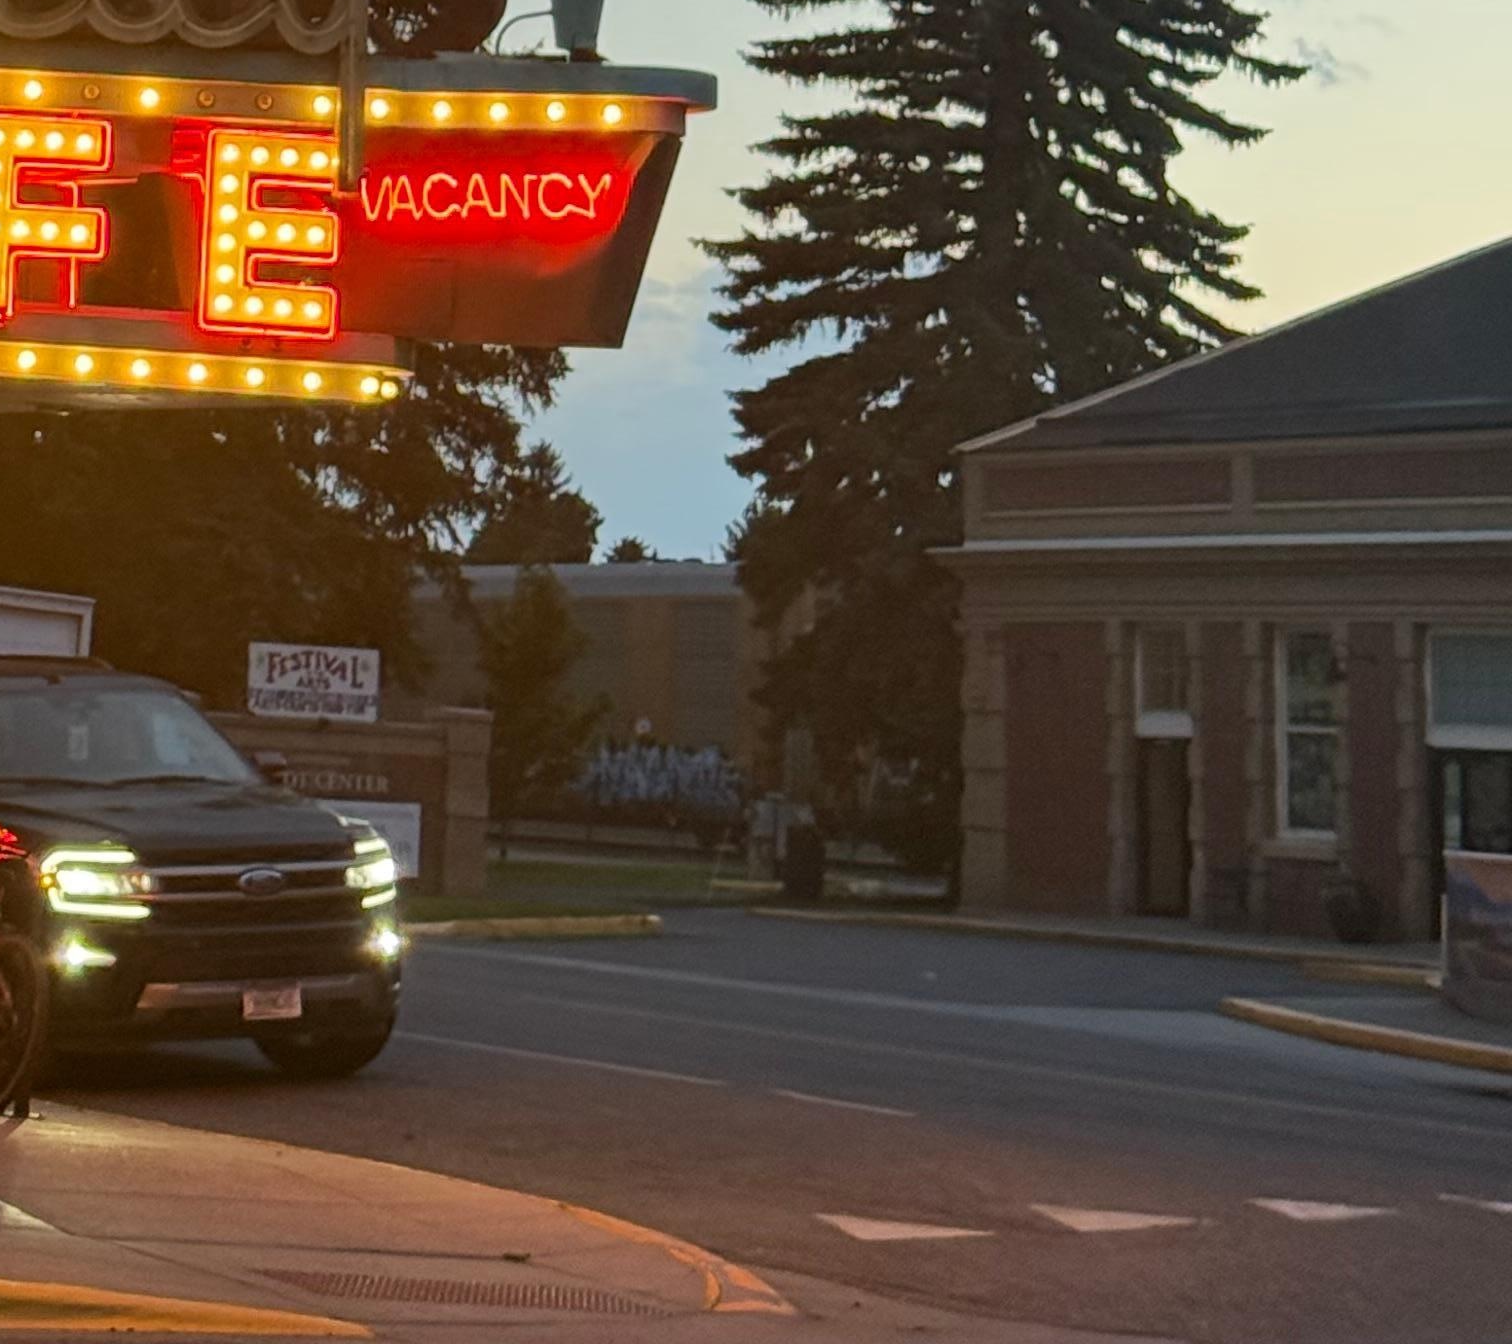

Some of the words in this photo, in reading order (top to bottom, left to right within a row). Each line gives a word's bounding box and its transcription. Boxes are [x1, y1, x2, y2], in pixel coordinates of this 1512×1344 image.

[359, 171, 612, 221] VACANCY
[265, 650, 364, 689] FESTIVAL
[315, 770, 389, 793] CENTER
